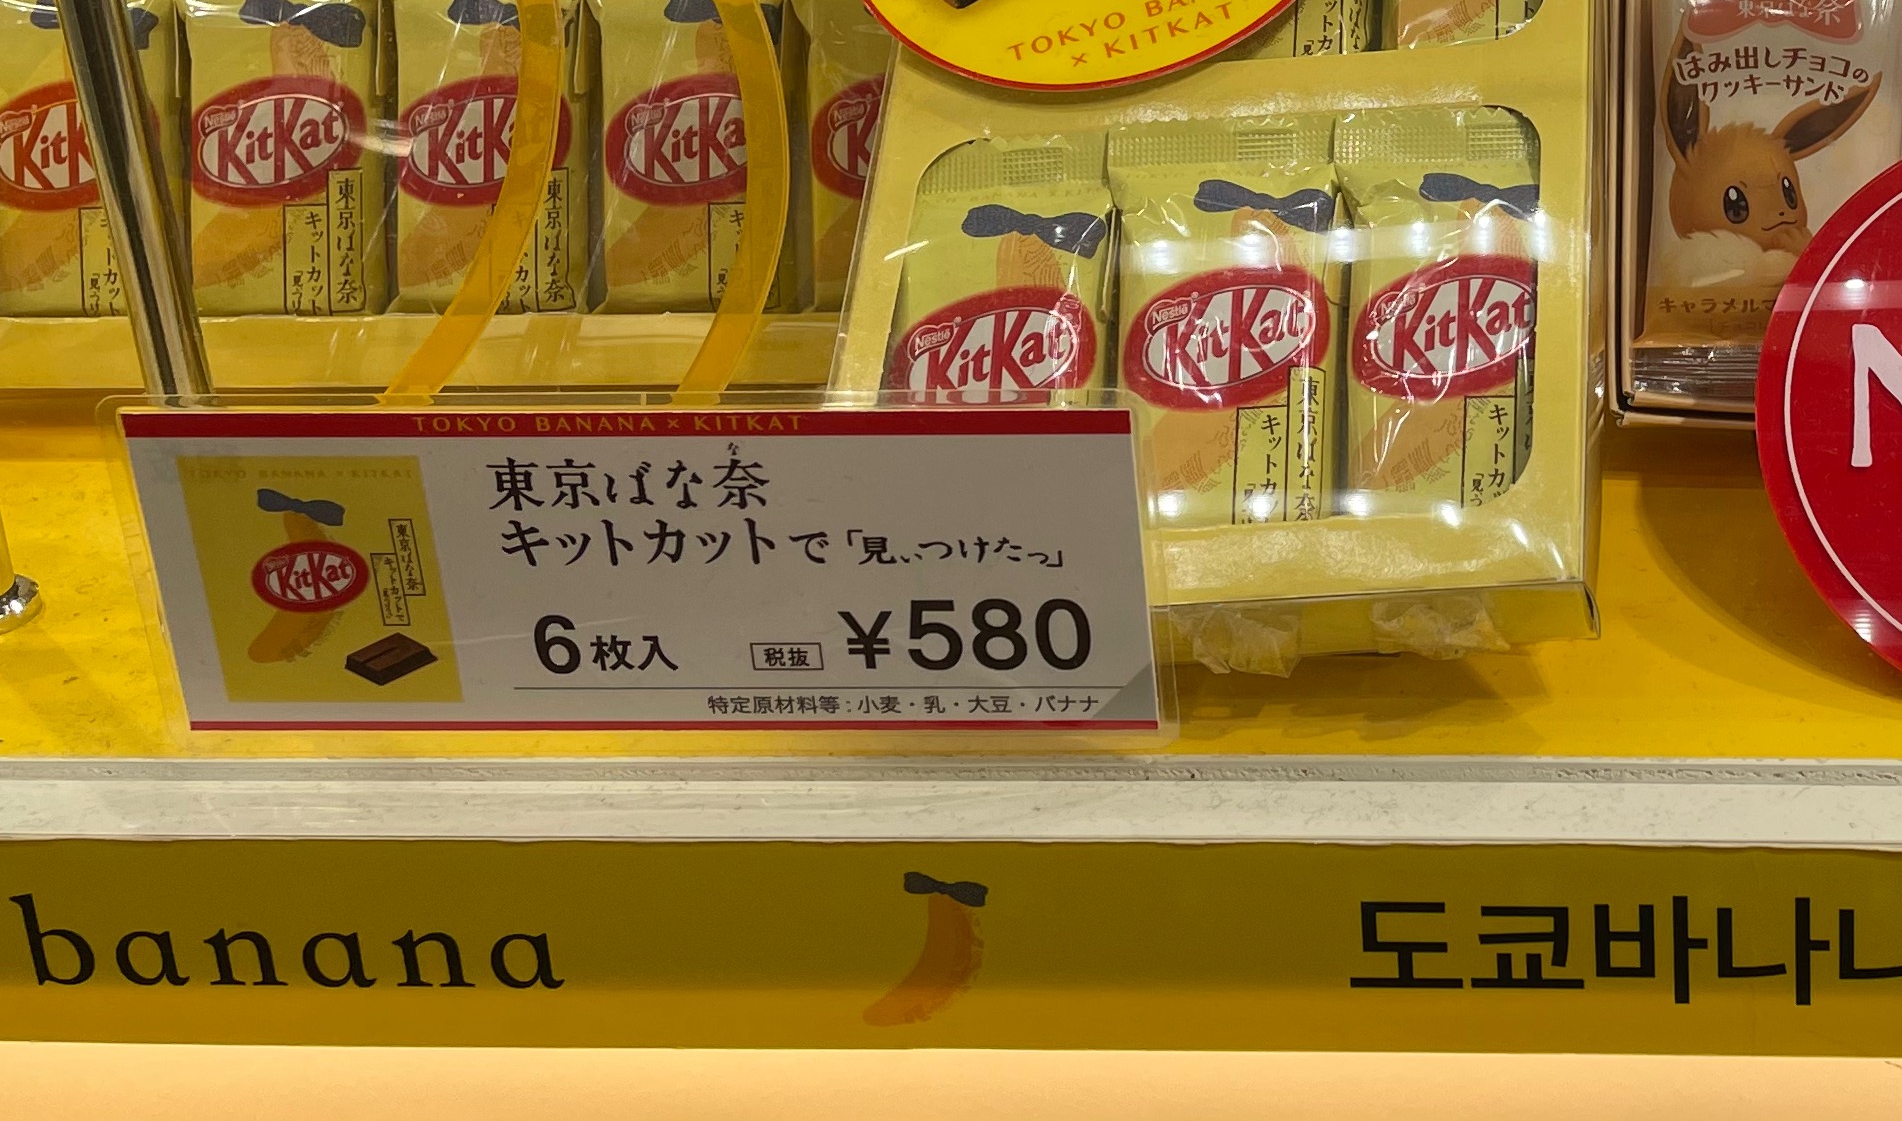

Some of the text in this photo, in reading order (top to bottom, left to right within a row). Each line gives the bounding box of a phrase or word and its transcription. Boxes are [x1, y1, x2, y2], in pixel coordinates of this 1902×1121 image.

[1007, 11, 1126, 62] TOKYO
[1105, 1, 1233, 57] KITKAT
[1701, 75, 1846, 103] クッキーサンド
[219, 96, 341, 186] KitKat
[933, 310, 1067, 390] KitKat
[1167, 288, 1304, 386] KitKat
[1394, 278, 1533, 376] KitKat
[414, 416, 517, 433] TOKYO
[536, 415, 655, 433] BANANA
[694, 414, 803, 433] KITKAT
[486, 457, 770, 511] 東京ばな奈
[500, 516, 829, 568] キットカットで
[277, 552, 352, 600] KitKat
[763, 647, 811, 668] 税抜
[837, 598, 1092, 671] ¥580
[9, 893, 565, 989] banana
